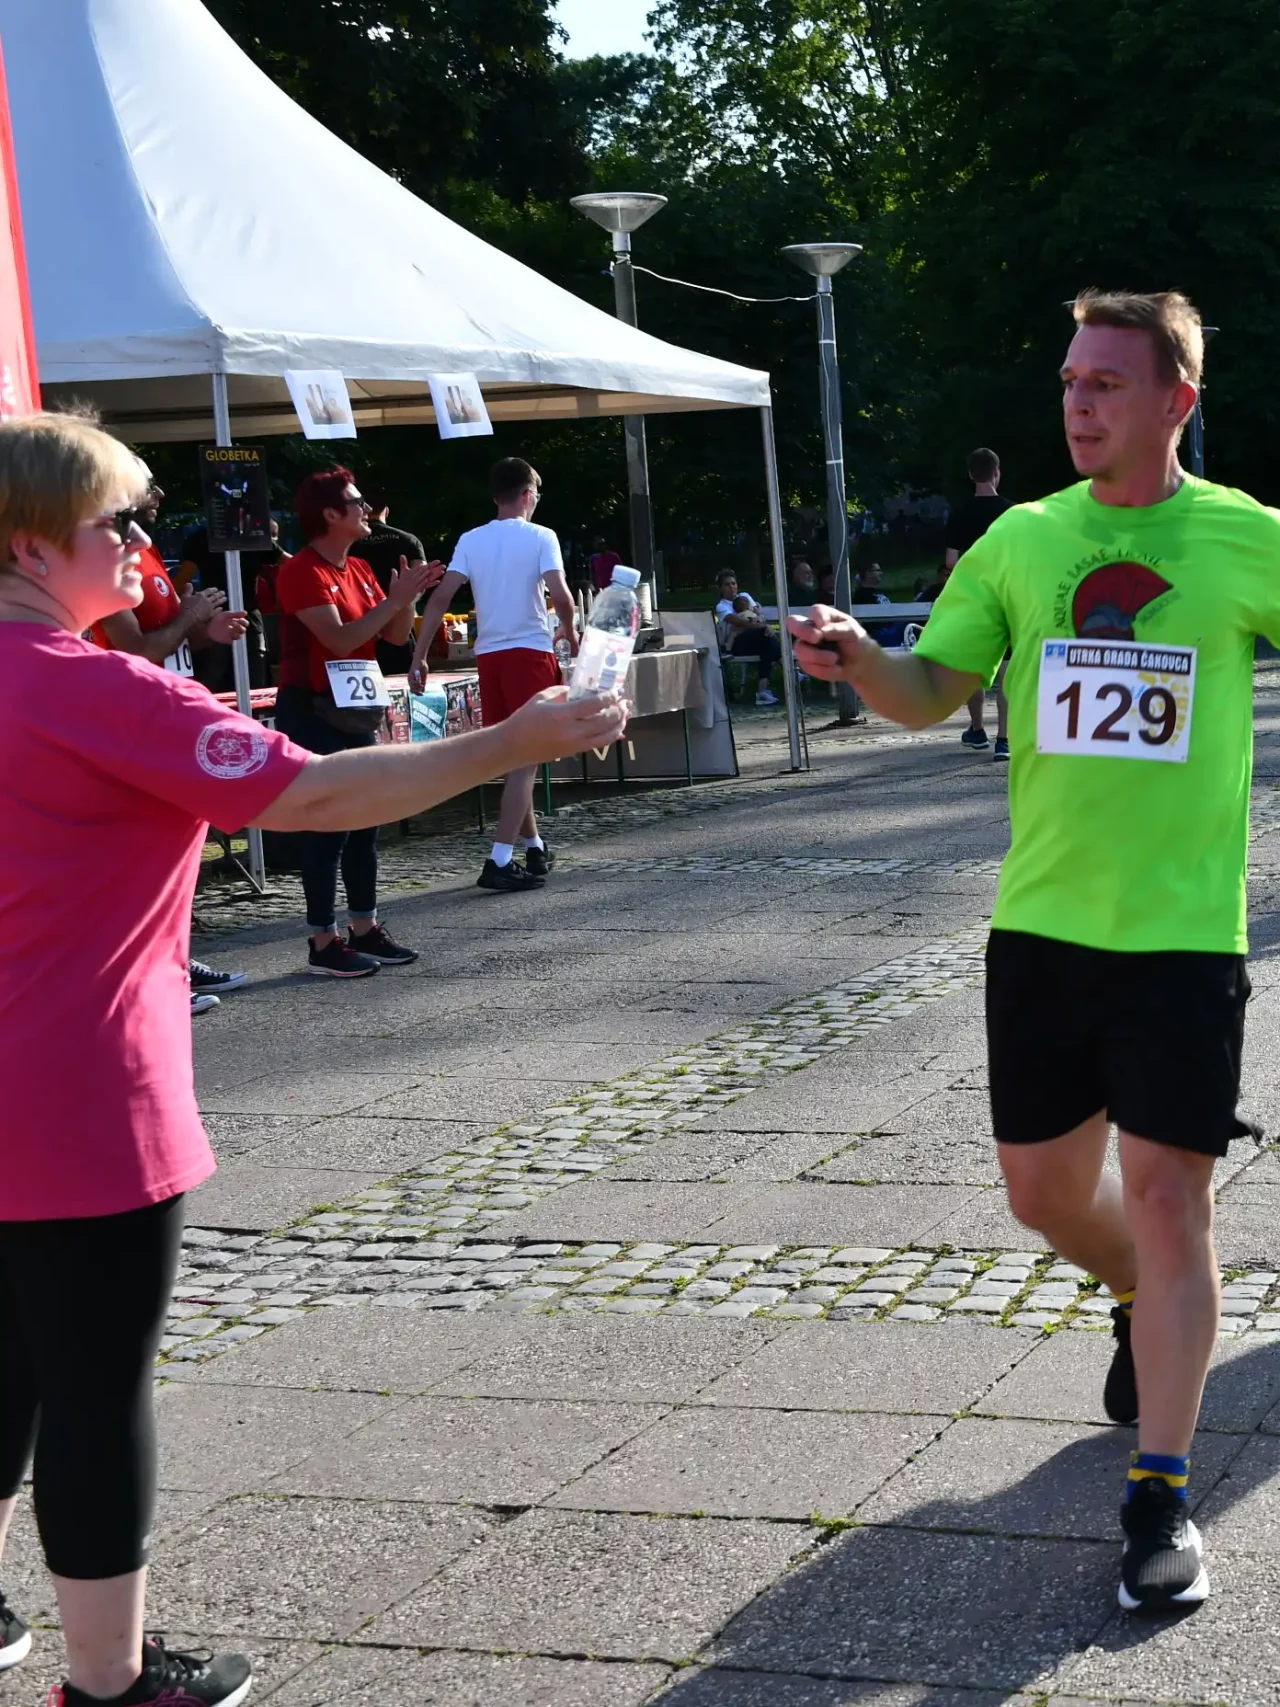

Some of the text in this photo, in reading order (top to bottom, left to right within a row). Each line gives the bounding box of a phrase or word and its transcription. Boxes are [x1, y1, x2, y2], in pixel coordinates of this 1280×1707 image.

[205, 450, 260, 461] GLOBETKA
[1069, 648, 1101, 664] UTRKA
[1103, 650, 1138, 667] GRADA
[346, 676, 377, 701] 29
[1056, 681, 1177, 746] 129
